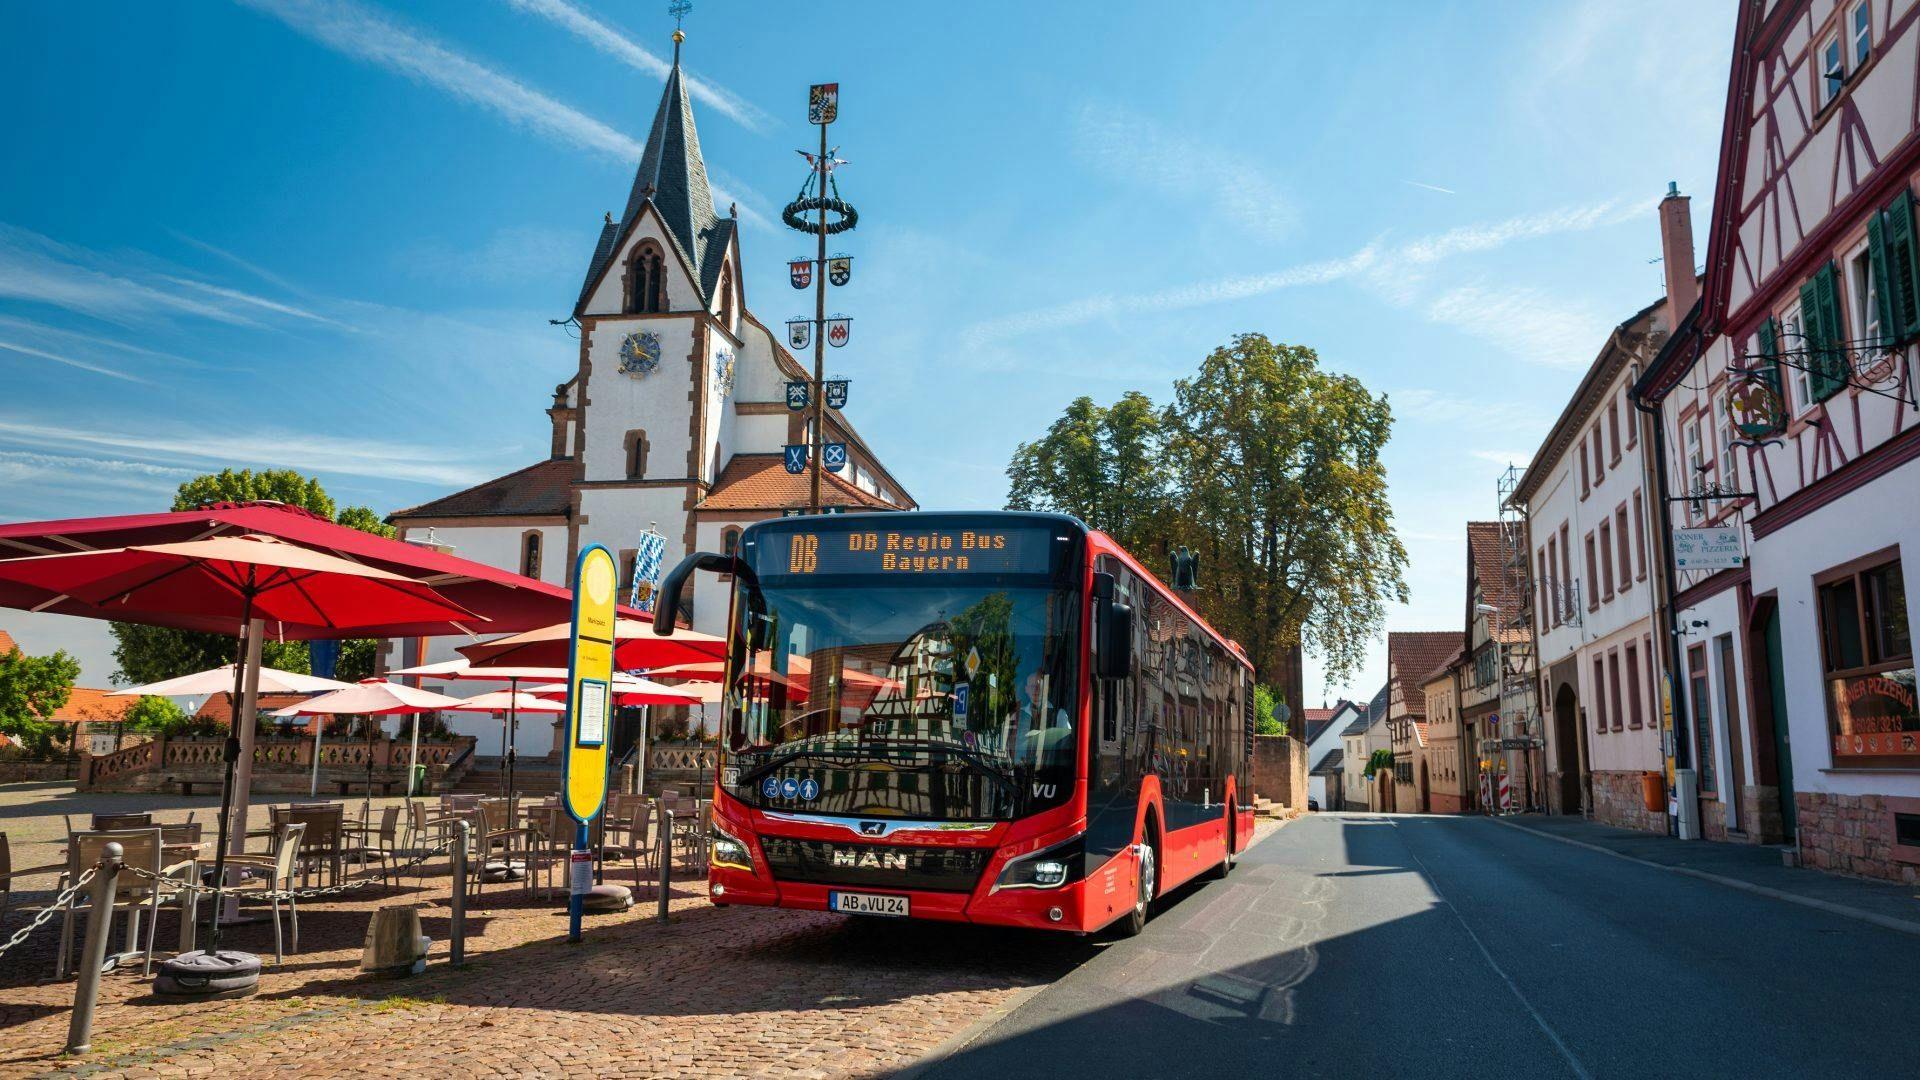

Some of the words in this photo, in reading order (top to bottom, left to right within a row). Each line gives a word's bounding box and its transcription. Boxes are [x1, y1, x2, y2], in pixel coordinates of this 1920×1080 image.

[849, 533, 878, 551] DB
[886, 532, 952, 552] Regio
[961, 531, 1006, 550] Bus
[1701, 545, 1740, 553] PIZZERIA
[790, 534, 818, 573] DB
[882, 553, 970, 572] Bayern
[1867, 677, 1913, 713] PIZZERIA
[724, 769, 738, 785] DB
[1032, 783, 1057, 799] VU
[833, 849, 907, 870] MAN
[842, 895, 859, 910] AB
[868, 897, 885, 912] VU
[887, 898, 904, 914] 24
